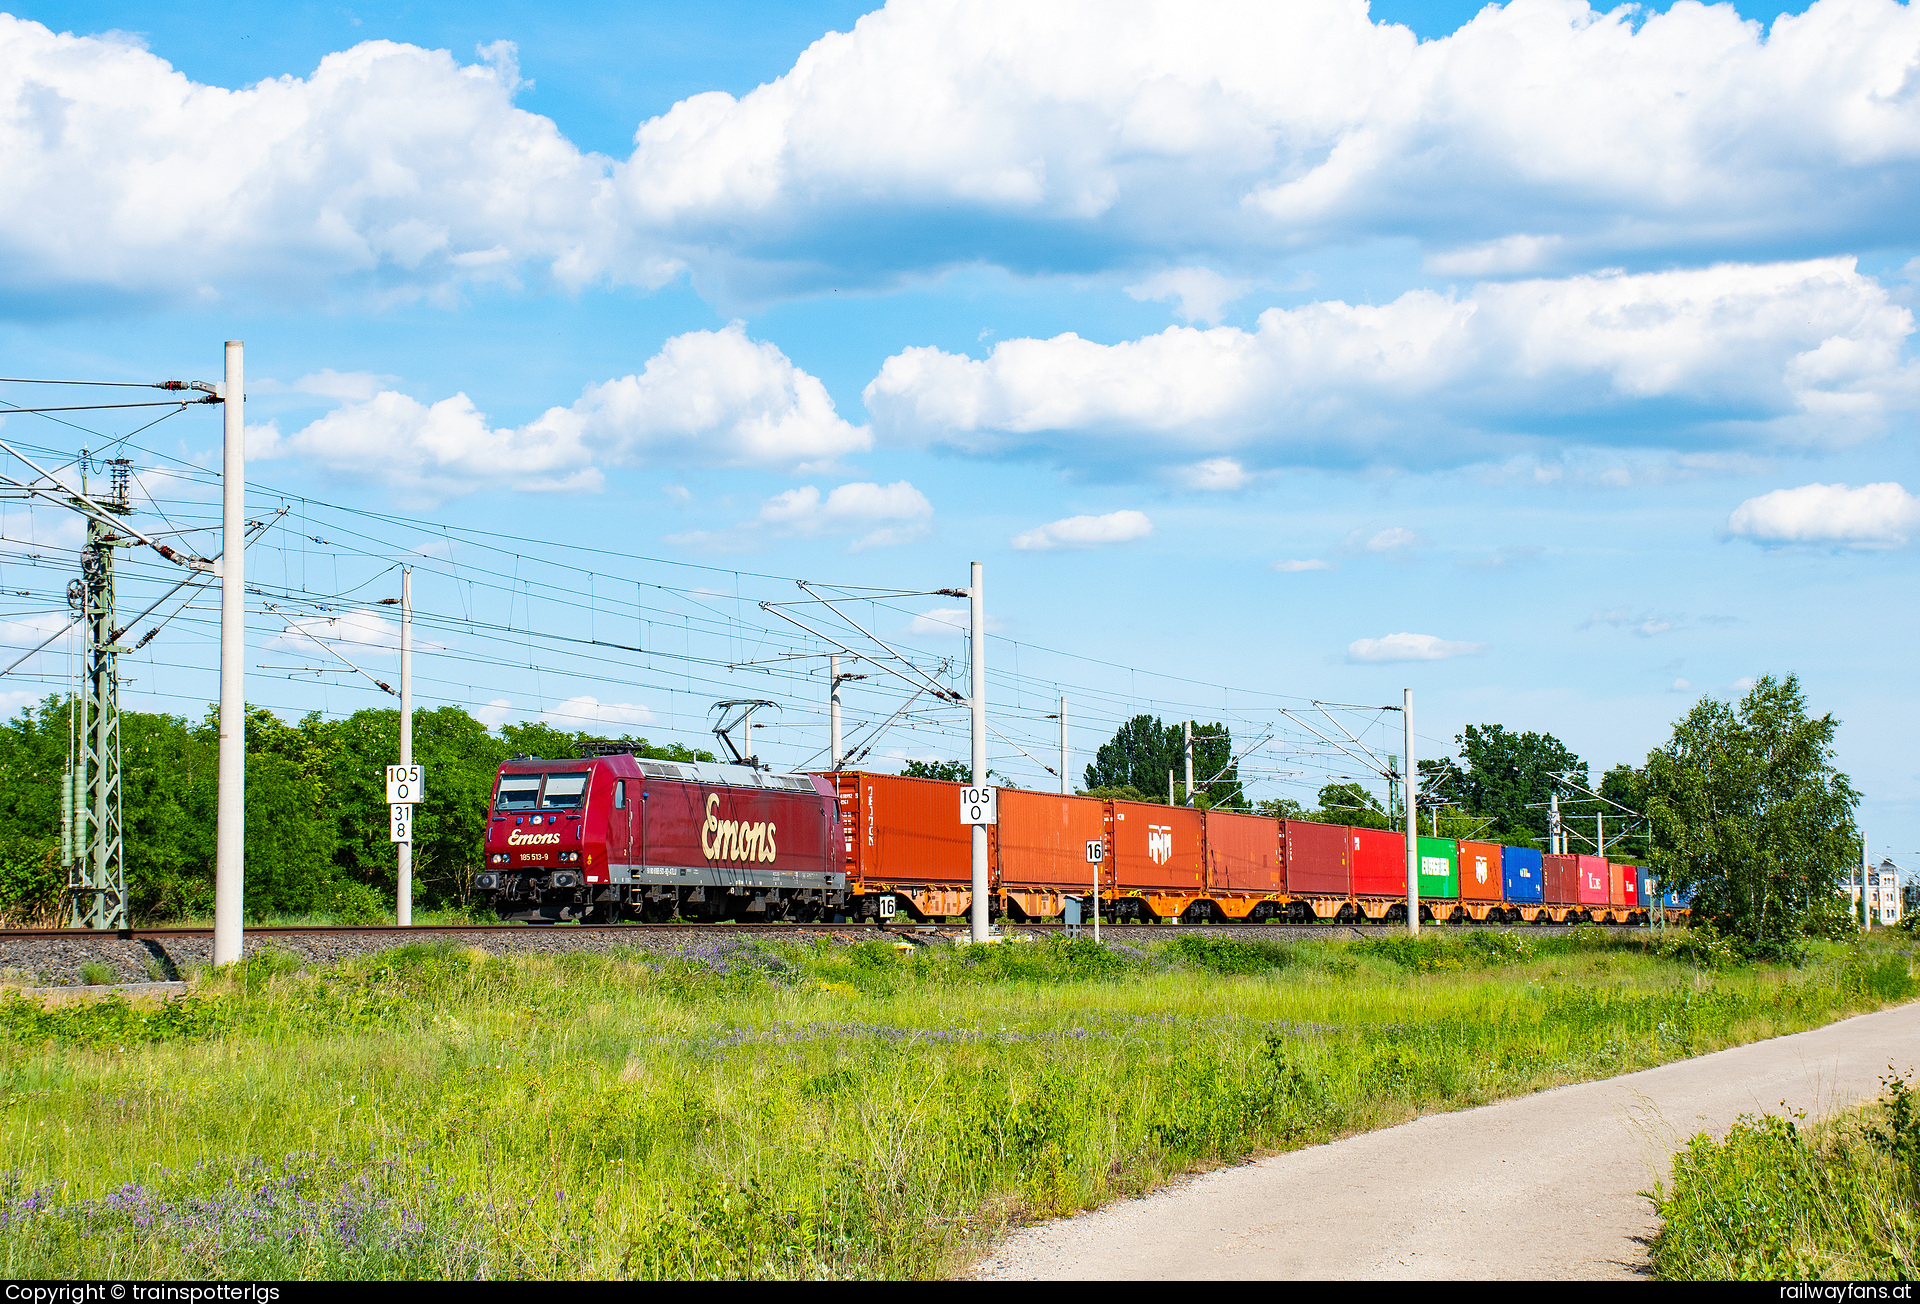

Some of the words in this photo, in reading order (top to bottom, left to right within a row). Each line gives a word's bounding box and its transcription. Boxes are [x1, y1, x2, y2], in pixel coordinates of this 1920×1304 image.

[388, 767, 418, 782] 105
[397, 784, 409, 799] 0
[962, 788, 990, 804] 105
[394, 806, 409, 821] 31
[970, 805, 981, 820] 0
[397, 823, 406, 837] 8
[701, 792, 777, 864] Emons
[508, 828, 561, 846] Emons
[520, 853, 531, 861] 185
[531, 853, 549, 861] 513-9
[1087, 843, 1101, 860] 16
[880, 898, 894, 915] 16
